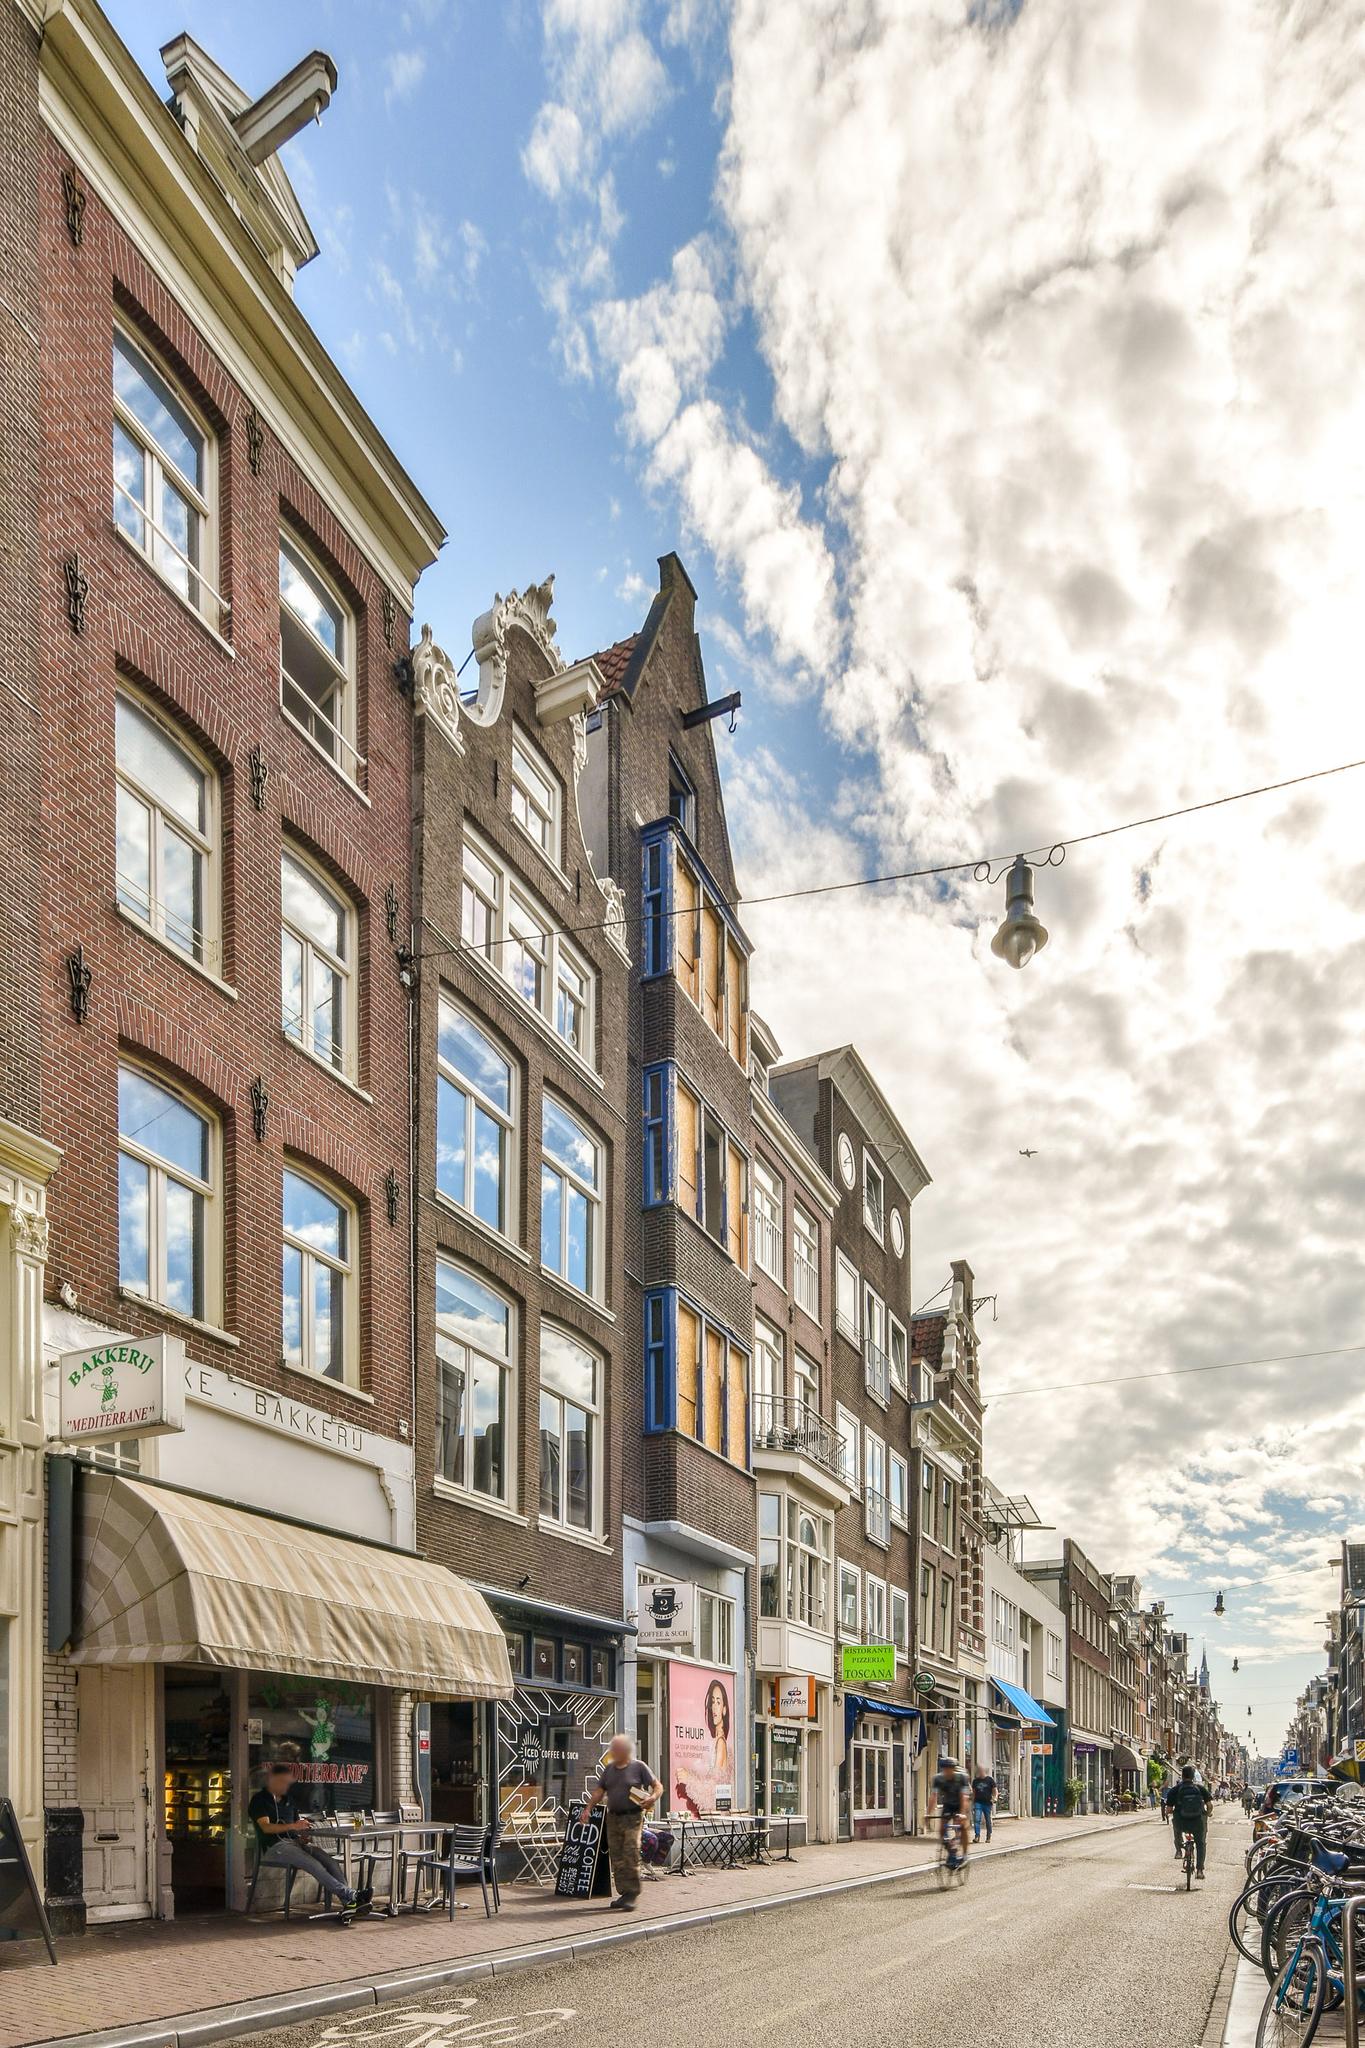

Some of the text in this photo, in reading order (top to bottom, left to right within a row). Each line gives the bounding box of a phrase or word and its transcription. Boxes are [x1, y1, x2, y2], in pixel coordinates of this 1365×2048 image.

[68, 1347, 155, 1387] BAKKERIJ
[67, 1405, 155, 1433] "MEDITERRANE"
[255, 1392, 363, 1452] BAKKERIJ
[852, 1656, 886, 1664] PIZZERIA
[844, 1668, 893, 1679] TOSCANA
[674, 1725, 705, 1740] TE HUUR
[541, 1749, 560, 1760] COFFEE
[566, 1751, 579, 1761] SUCH
[1287, 1750, 1295, 1760] P
[577, 1846, 596, 1892] COFFEE
